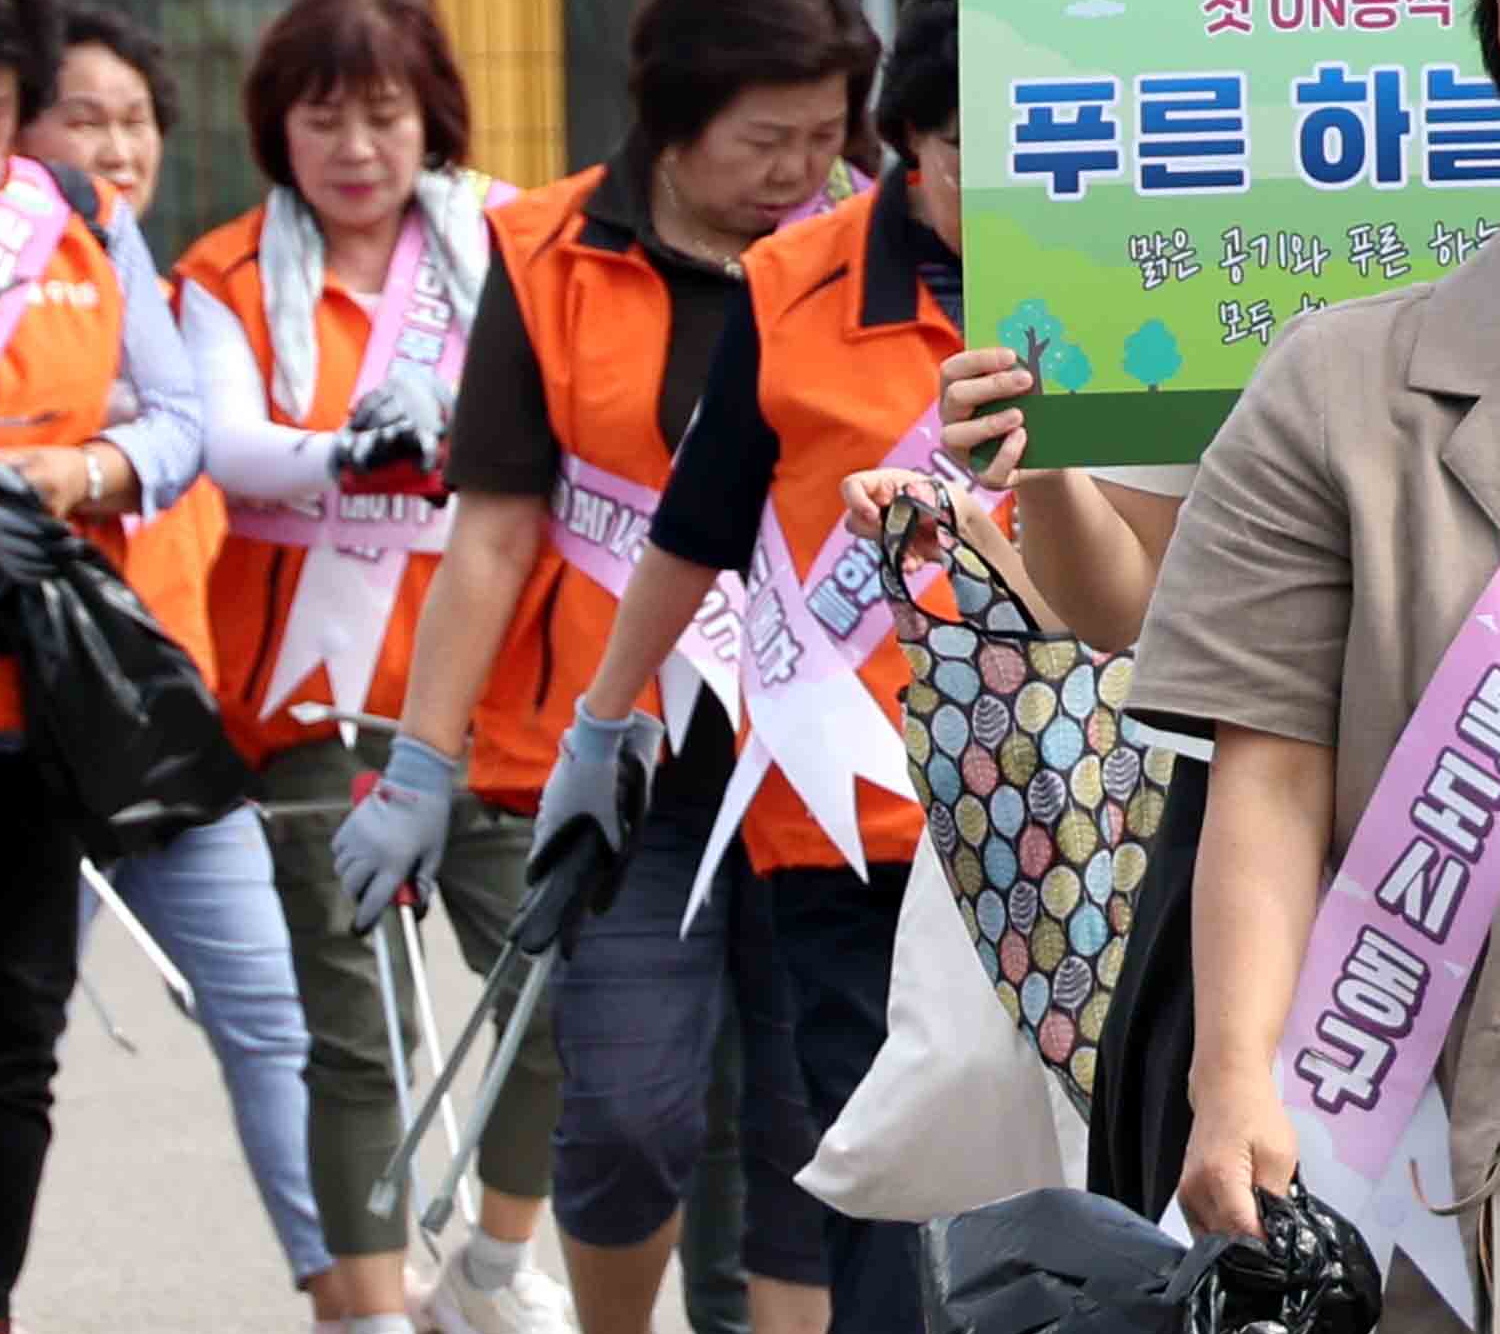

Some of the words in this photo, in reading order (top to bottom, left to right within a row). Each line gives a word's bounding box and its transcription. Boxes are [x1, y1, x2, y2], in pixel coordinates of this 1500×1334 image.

[1009, 72, 1249, 200] 푸른
[1129, 228, 1201, 290] 맑은
[1218, 225, 1330, 284] 공기와
[1347, 221, 1412, 280] 푸른
[1218, 298, 1276, 346] 모두
[1297, 924, 1432, 1113] 동구
